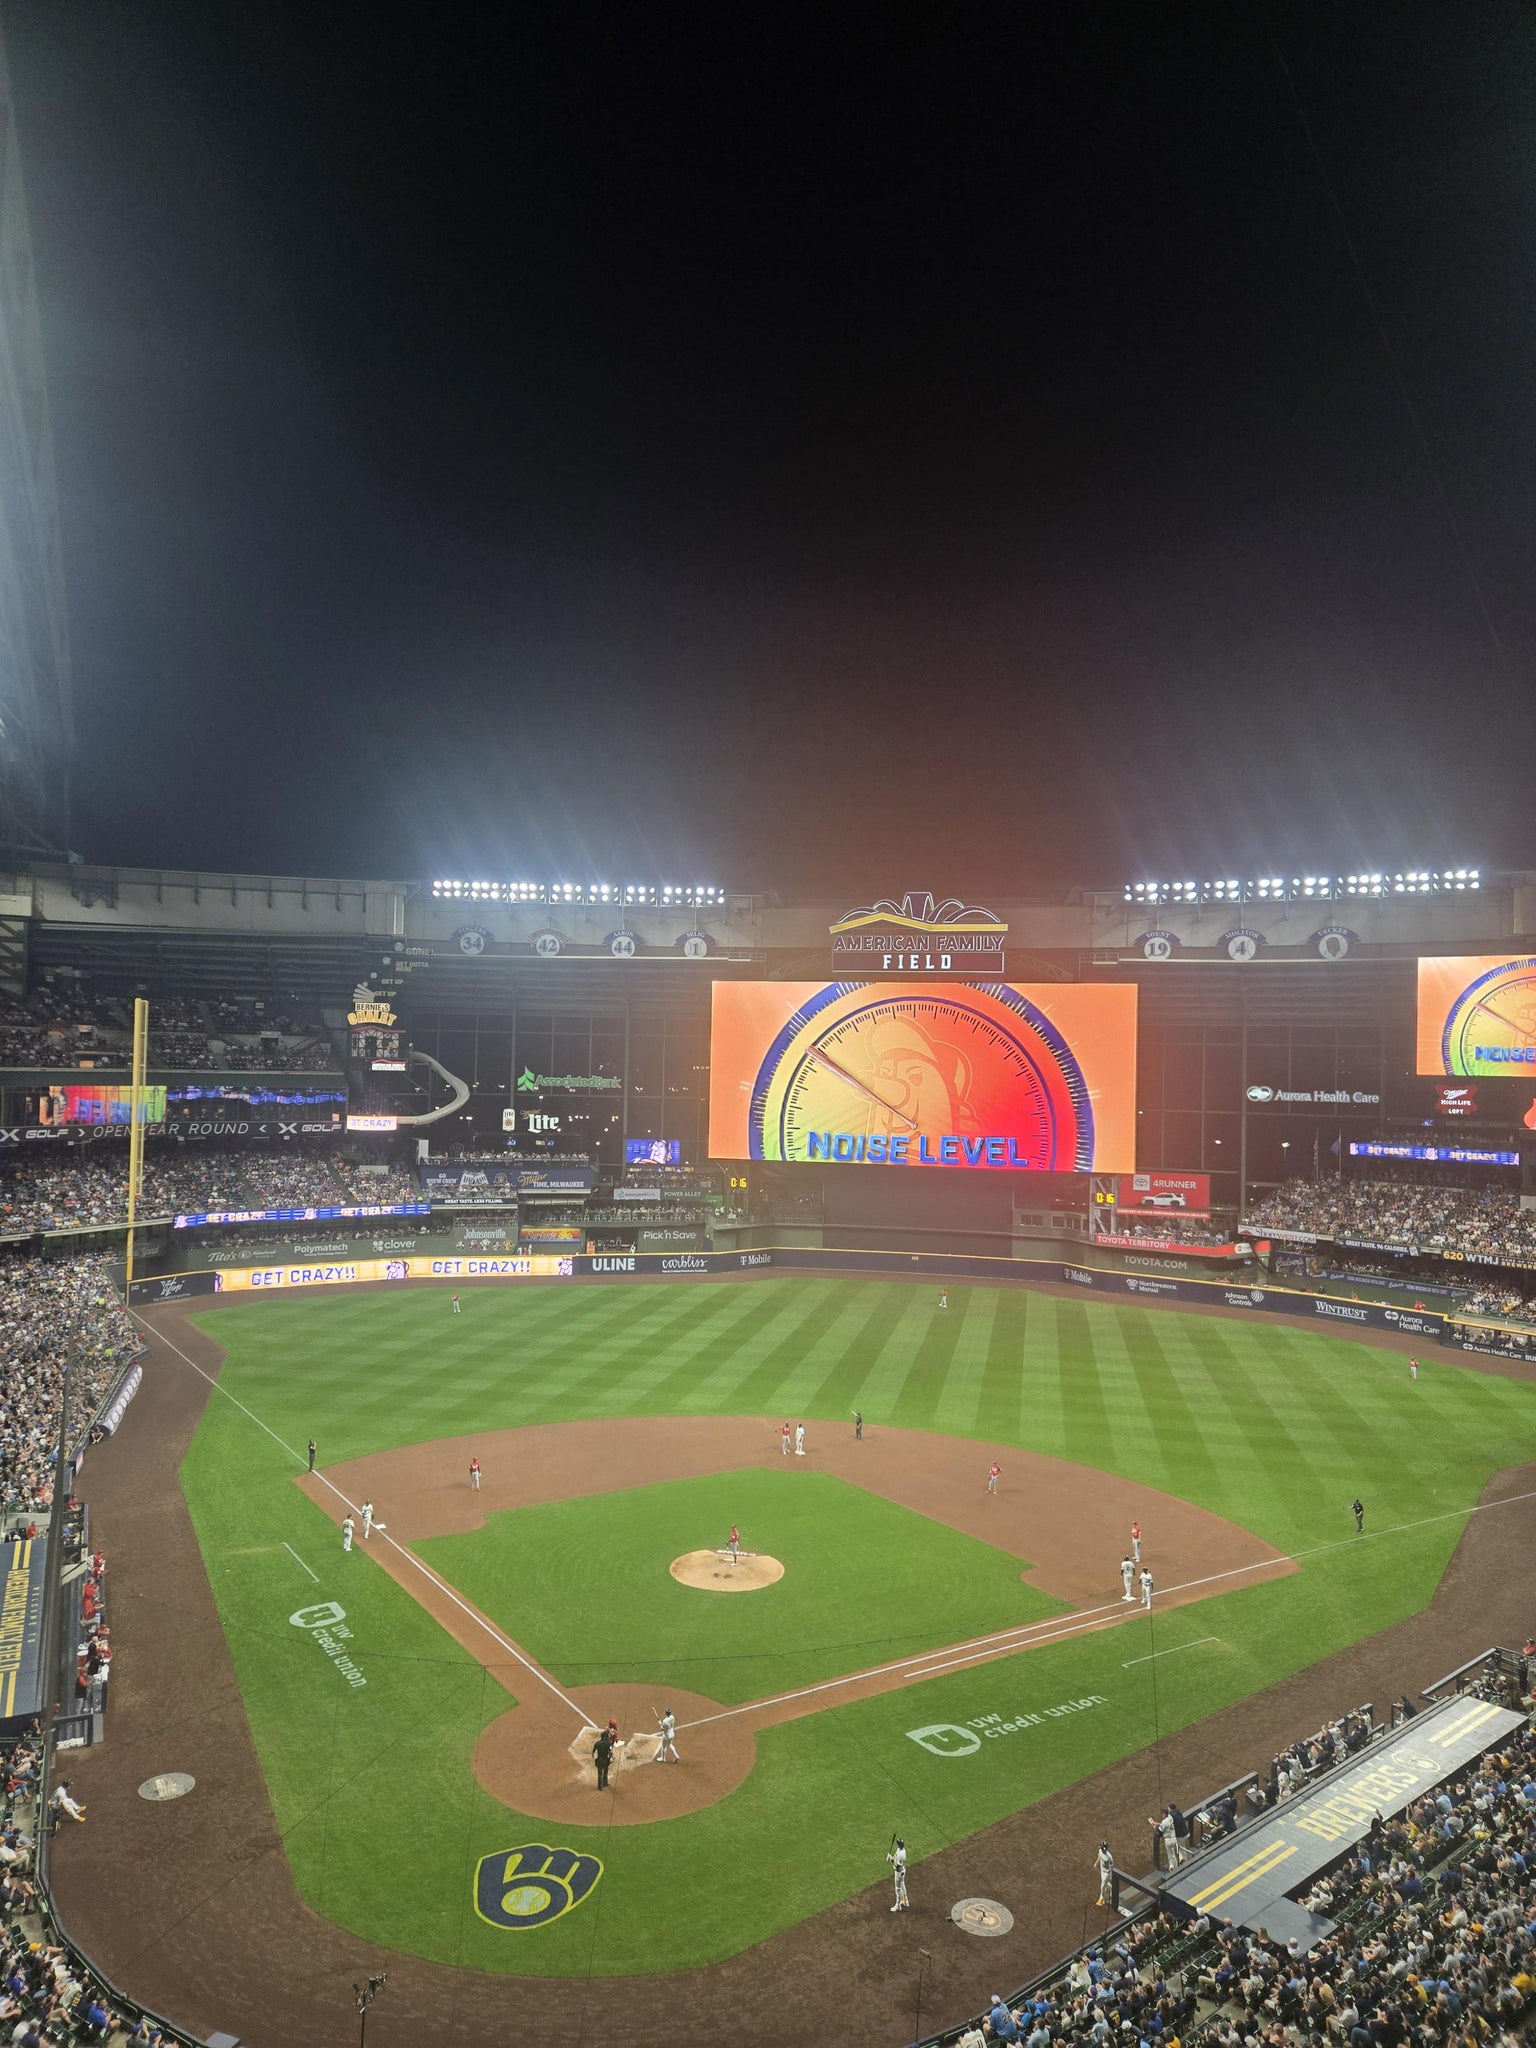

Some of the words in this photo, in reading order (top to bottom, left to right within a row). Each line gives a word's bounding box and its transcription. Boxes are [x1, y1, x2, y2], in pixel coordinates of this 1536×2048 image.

[1145, 930, 1171, 939] YOUNT
[1225, 929, 1260, 940] MOLITOR
[1317, 927, 1348, 936] UECKER
[462, 936, 481, 951] 34
[538, 939, 558, 953] 42
[614, 940, 634, 953] 44
[692, 943, 700, 956] 1
[833, 936, 930, 951] AMERICAN
[935, 936, 1005, 951] FAMILY
[1148, 941, 1169, 957] 19
[1235, 940, 1246, 956] 4
[405, 947, 434, 956] GONE!
[882, 954, 951, 969] FIELD
[356, 1003, 389, 1012] BERNIE'S
[347, 1010, 398, 1027] CHALET
[1475, 1045, 1536, 1063] NOISE
[1274, 1089, 1312, 1102] Aurora
[1313, 1090, 1351, 1103] Health
[1352, 1092, 1380, 1104] Care
[188, 1122, 249, 1135] ROUND
[278, 1122, 298, 1134] X
[301, 1123, 342, 1132] GOLF
[527, 1114, 560, 1133] Lite
[0, 1129, 20, 1142] X
[25, 1129, 69, 1139] GOLF
[806, 1130, 910, 1162] NOISE
[919, 1134, 1028, 1166] LEVEL
[517, 1173, 549, 1187] Miller
[533, 1181, 549, 1189] TIME,
[1152, 1179, 1197, 1189] 4RUNNER
[463, 1228, 506, 1239] Johnsonville
[643, 1231, 663, 1240] Pick
[672, 1231, 697, 1240] Save
[294, 1243, 348, 1254] Polymatech
[384, 1239, 416, 1250] clover
[1098, 1236, 1126, 1245] TOYOTA
[1128, 1239, 1170, 1249] TERRITORY
[1345, 1239, 1361, 1247] GREAT
[208, 1251, 237, 1263] Tito's
[592, 1257, 636, 1271] ULINE
[661, 1256, 708, 1269] carbliss
[748, 1254, 772, 1265] Mobile
[1123, 1255, 1188, 1270] TOYOTA.COM
[1443, 1250, 1464, 1261] 620
[1465, 1253, 1499, 1265] WTMJ
[432, 1261, 463, 1274] GET
[468, 1260, 531, 1273] CRAZY!!
[251, 1271, 282, 1286] GET
[290, 1266, 356, 1283] CRAZY!!
[1070, 1269, 1093, 1284] Mobile
[1138, 1280, 1177, 1290] Northwestern
[1138, 1285, 1159, 1293] Mutual
[1225, 1291, 1248, 1300] Johnson
[1228, 1297, 1252, 1306] Controls
[1315, 1300, 1368, 1318] WINTRUST
[1399, 1314, 1423, 1324] Aurora
[1399, 1321, 1422, 1332] Health
[1423, 1325, 1440, 1335] Care
[1473, 1346, 1490, 1354] Aurora
[1491, 1349, 1508, 1357] Health
[3, 1568, 30, 1611] AMERICAN
[0, 1610, 27, 1642] FAMILY
[331, 1624, 354, 1638] uw
[0, 1641, 22, 1672] FIELD
[311, 1628, 346, 1656] credit
[333, 1655, 367, 1688] union
[966, 1712, 1002, 1728] uw
[984, 1713, 1047, 1738] credit
[1044, 1695, 1109, 1717] union
[1294, 1764, 1420, 1842] BREWERS
